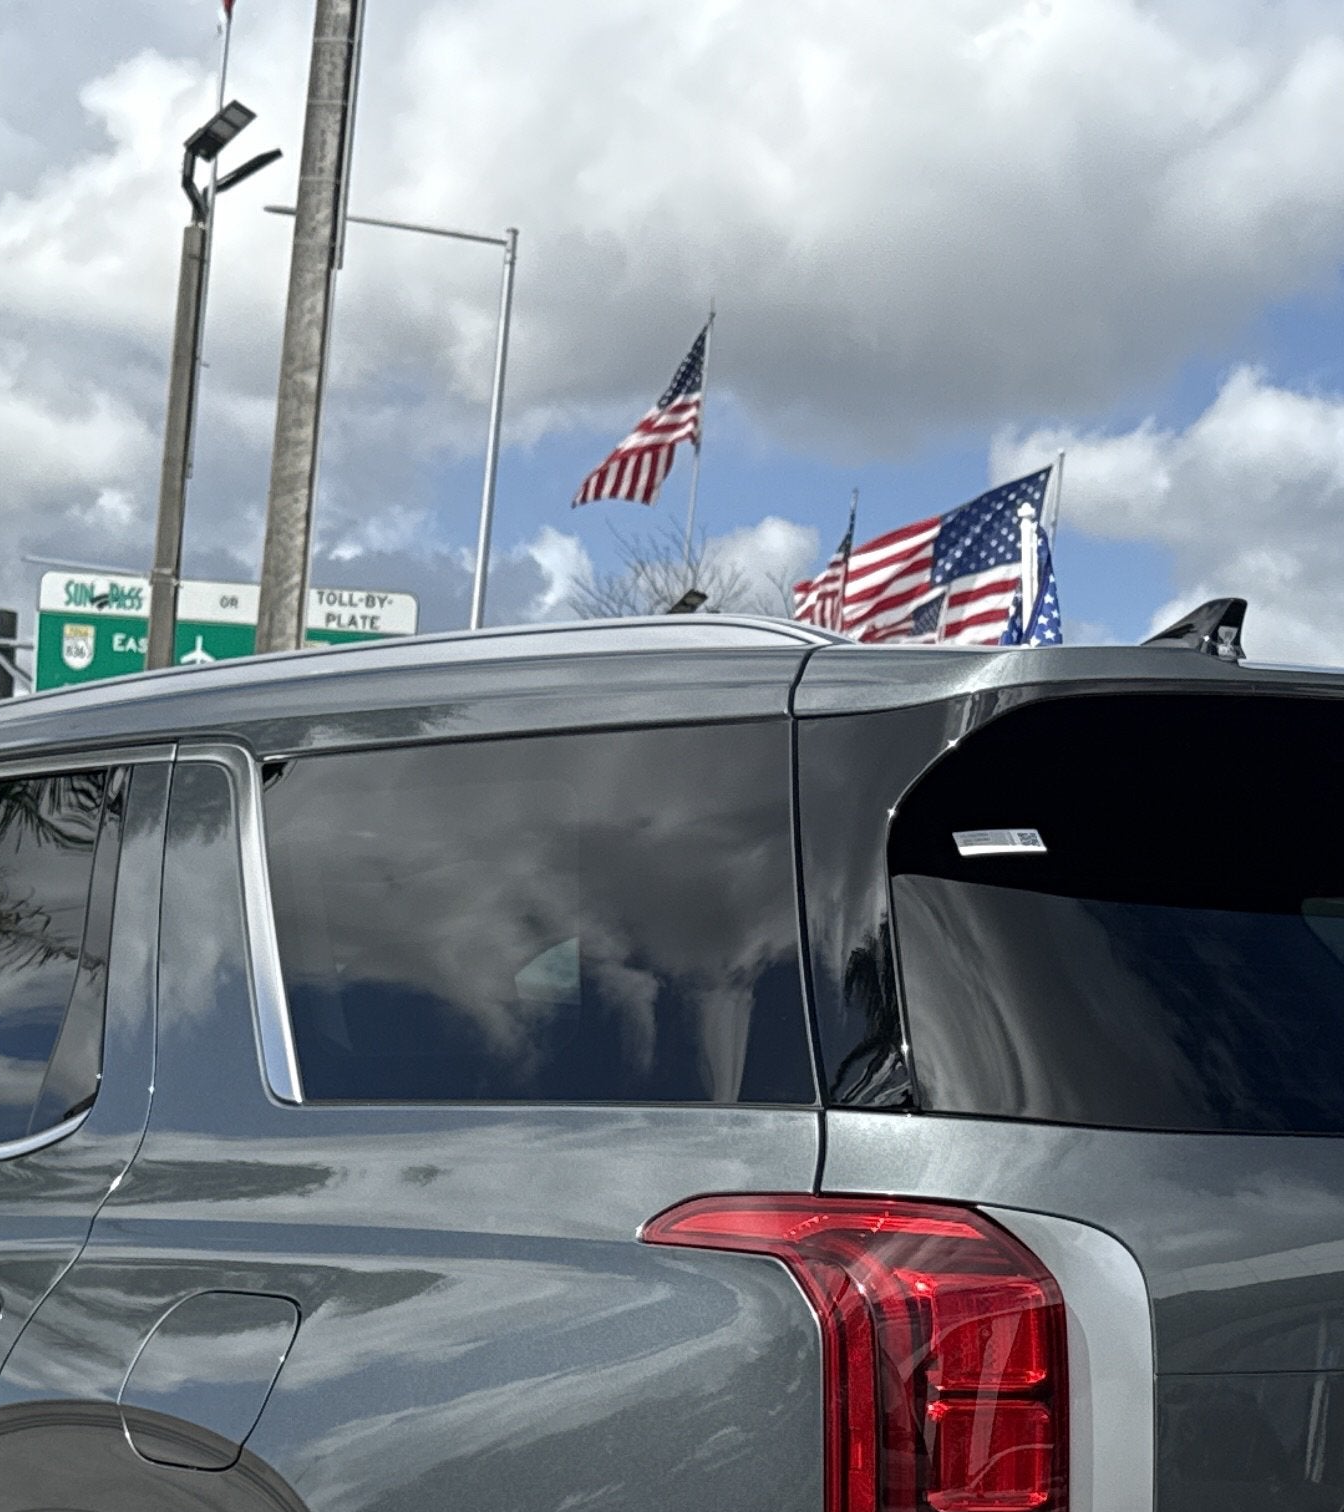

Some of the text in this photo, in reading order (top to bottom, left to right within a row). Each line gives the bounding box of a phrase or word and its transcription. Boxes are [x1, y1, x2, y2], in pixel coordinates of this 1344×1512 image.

[219, 595, 239, 609] OR
[324, 612, 381, 631] PLATE
[112, 632, 148, 655] EAS
